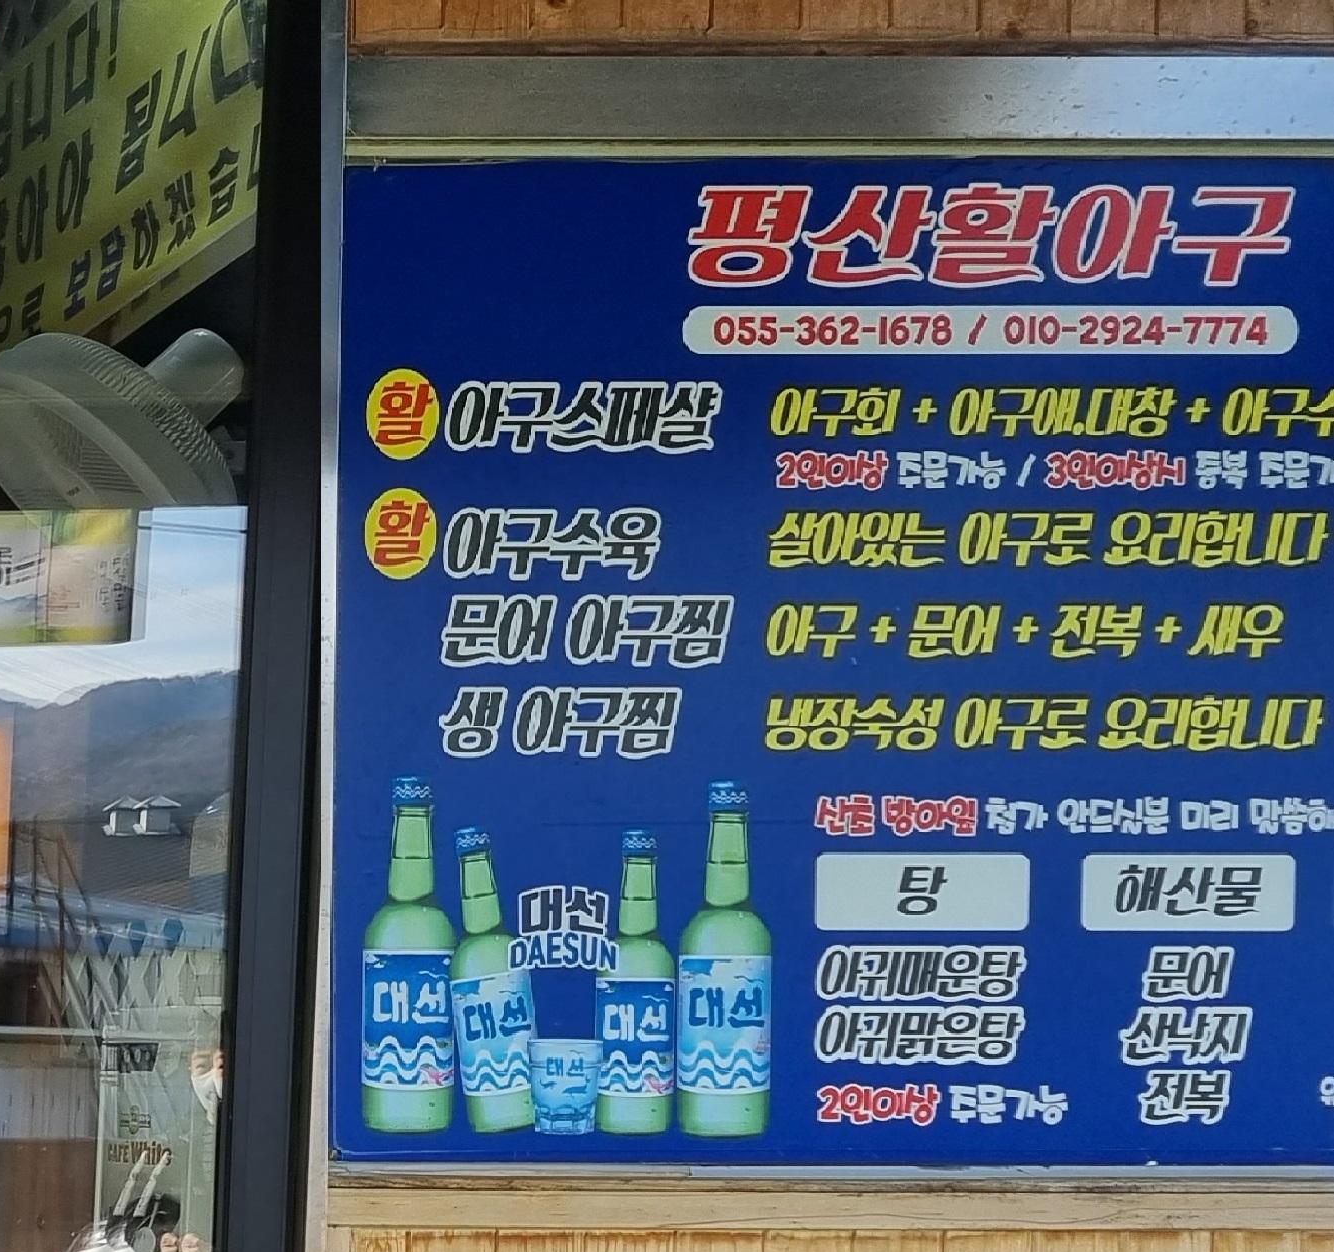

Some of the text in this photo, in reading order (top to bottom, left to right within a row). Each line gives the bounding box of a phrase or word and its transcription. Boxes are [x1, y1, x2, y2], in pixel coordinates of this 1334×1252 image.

[688, 183, 1296, 288] 평산활아구
[714, 315, 952, 346] 055-362-1678
[1004, 315, 1268, 346] 010-2924-7774
[375, 381, 433, 446] 활
[445, 381, 722, 453] 아구스페샬
[771, 386, 900, 438] 아구회
[776, 449, 889, 491] 2인이상
[897, 450, 1006, 490] 주문가능
[1044, 448, 1187, 491] 3인이상시
[1195, 449, 1248, 490] 중복
[372, 500, 1330, 581] 활 아구수육 살아있는 아구로 요리합니다
[441, 594, 557, 666] 문어
[565, 594, 734, 668] 아구찜
[765, 603, 858, 658] 아구
[907, 603, 1002, 658] 문어
[1049, 603, 1144, 658] 전복
[1187, 603, 1284, 658] 새우
[438, 686, 1324, 760] 생 아구찜 냉장숙성 아구로 요리합니다
[815, 795, 876, 837] 산초
[882, 795, 978, 837] 방아잎
[1057, 797, 1170, 834] 안드실분
[1181, 800, 1239, 831] 미리
[518, 886, 610, 936] 대선
[896, 864, 1263, 917] 탕 해산물
[508, 930, 620, 970] DAESUN
[817, 945, 1234, 1001] 아귀매운탕 문어
[371, 980, 451, 1024] 대선
[462, 996, 532, 1042] 대선
[603, 1003, 670, 1042] 대선
[688, 986, 765, 1029] 대선
[815, 1005, 1253, 1066] 아귀맑은탕 산낙지
[546, 1055, 585, 1077] 대선
[817, 1069, 1230, 1126] 2인이상 주문가능 전복
